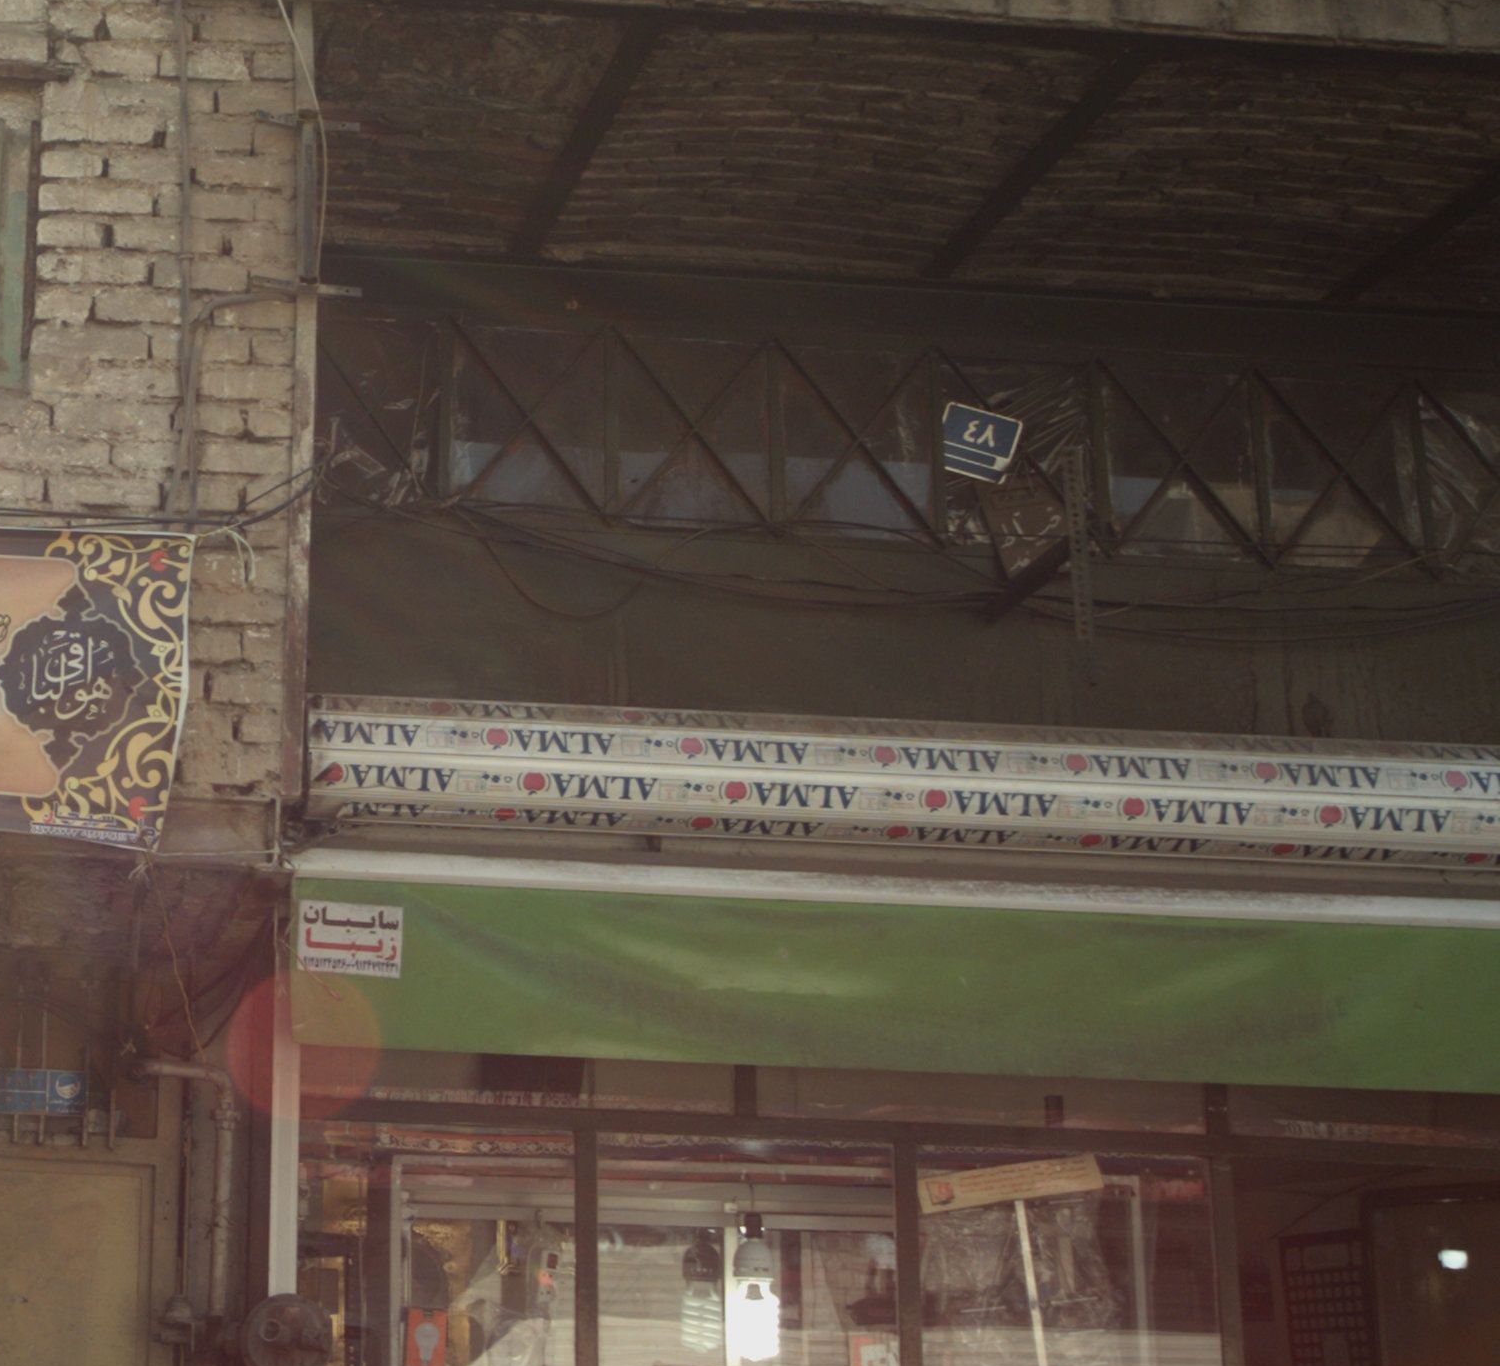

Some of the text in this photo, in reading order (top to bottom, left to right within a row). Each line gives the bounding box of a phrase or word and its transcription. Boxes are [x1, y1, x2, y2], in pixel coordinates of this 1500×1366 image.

[512, 728, 616, 756] ALMA
[707, 737, 810, 766] ALMA
[899, 746, 1003, 773] ALMA
[1090, 753, 1192, 781] ALMA
[1279, 762, 1382, 789] ALMA
[349, 764, 1452, 833] ALMA ALMA ALMA ALMA ALMA ALMA
[303, 905, 399, 934] سایبان
[304, 926, 398, 961] زیبا
